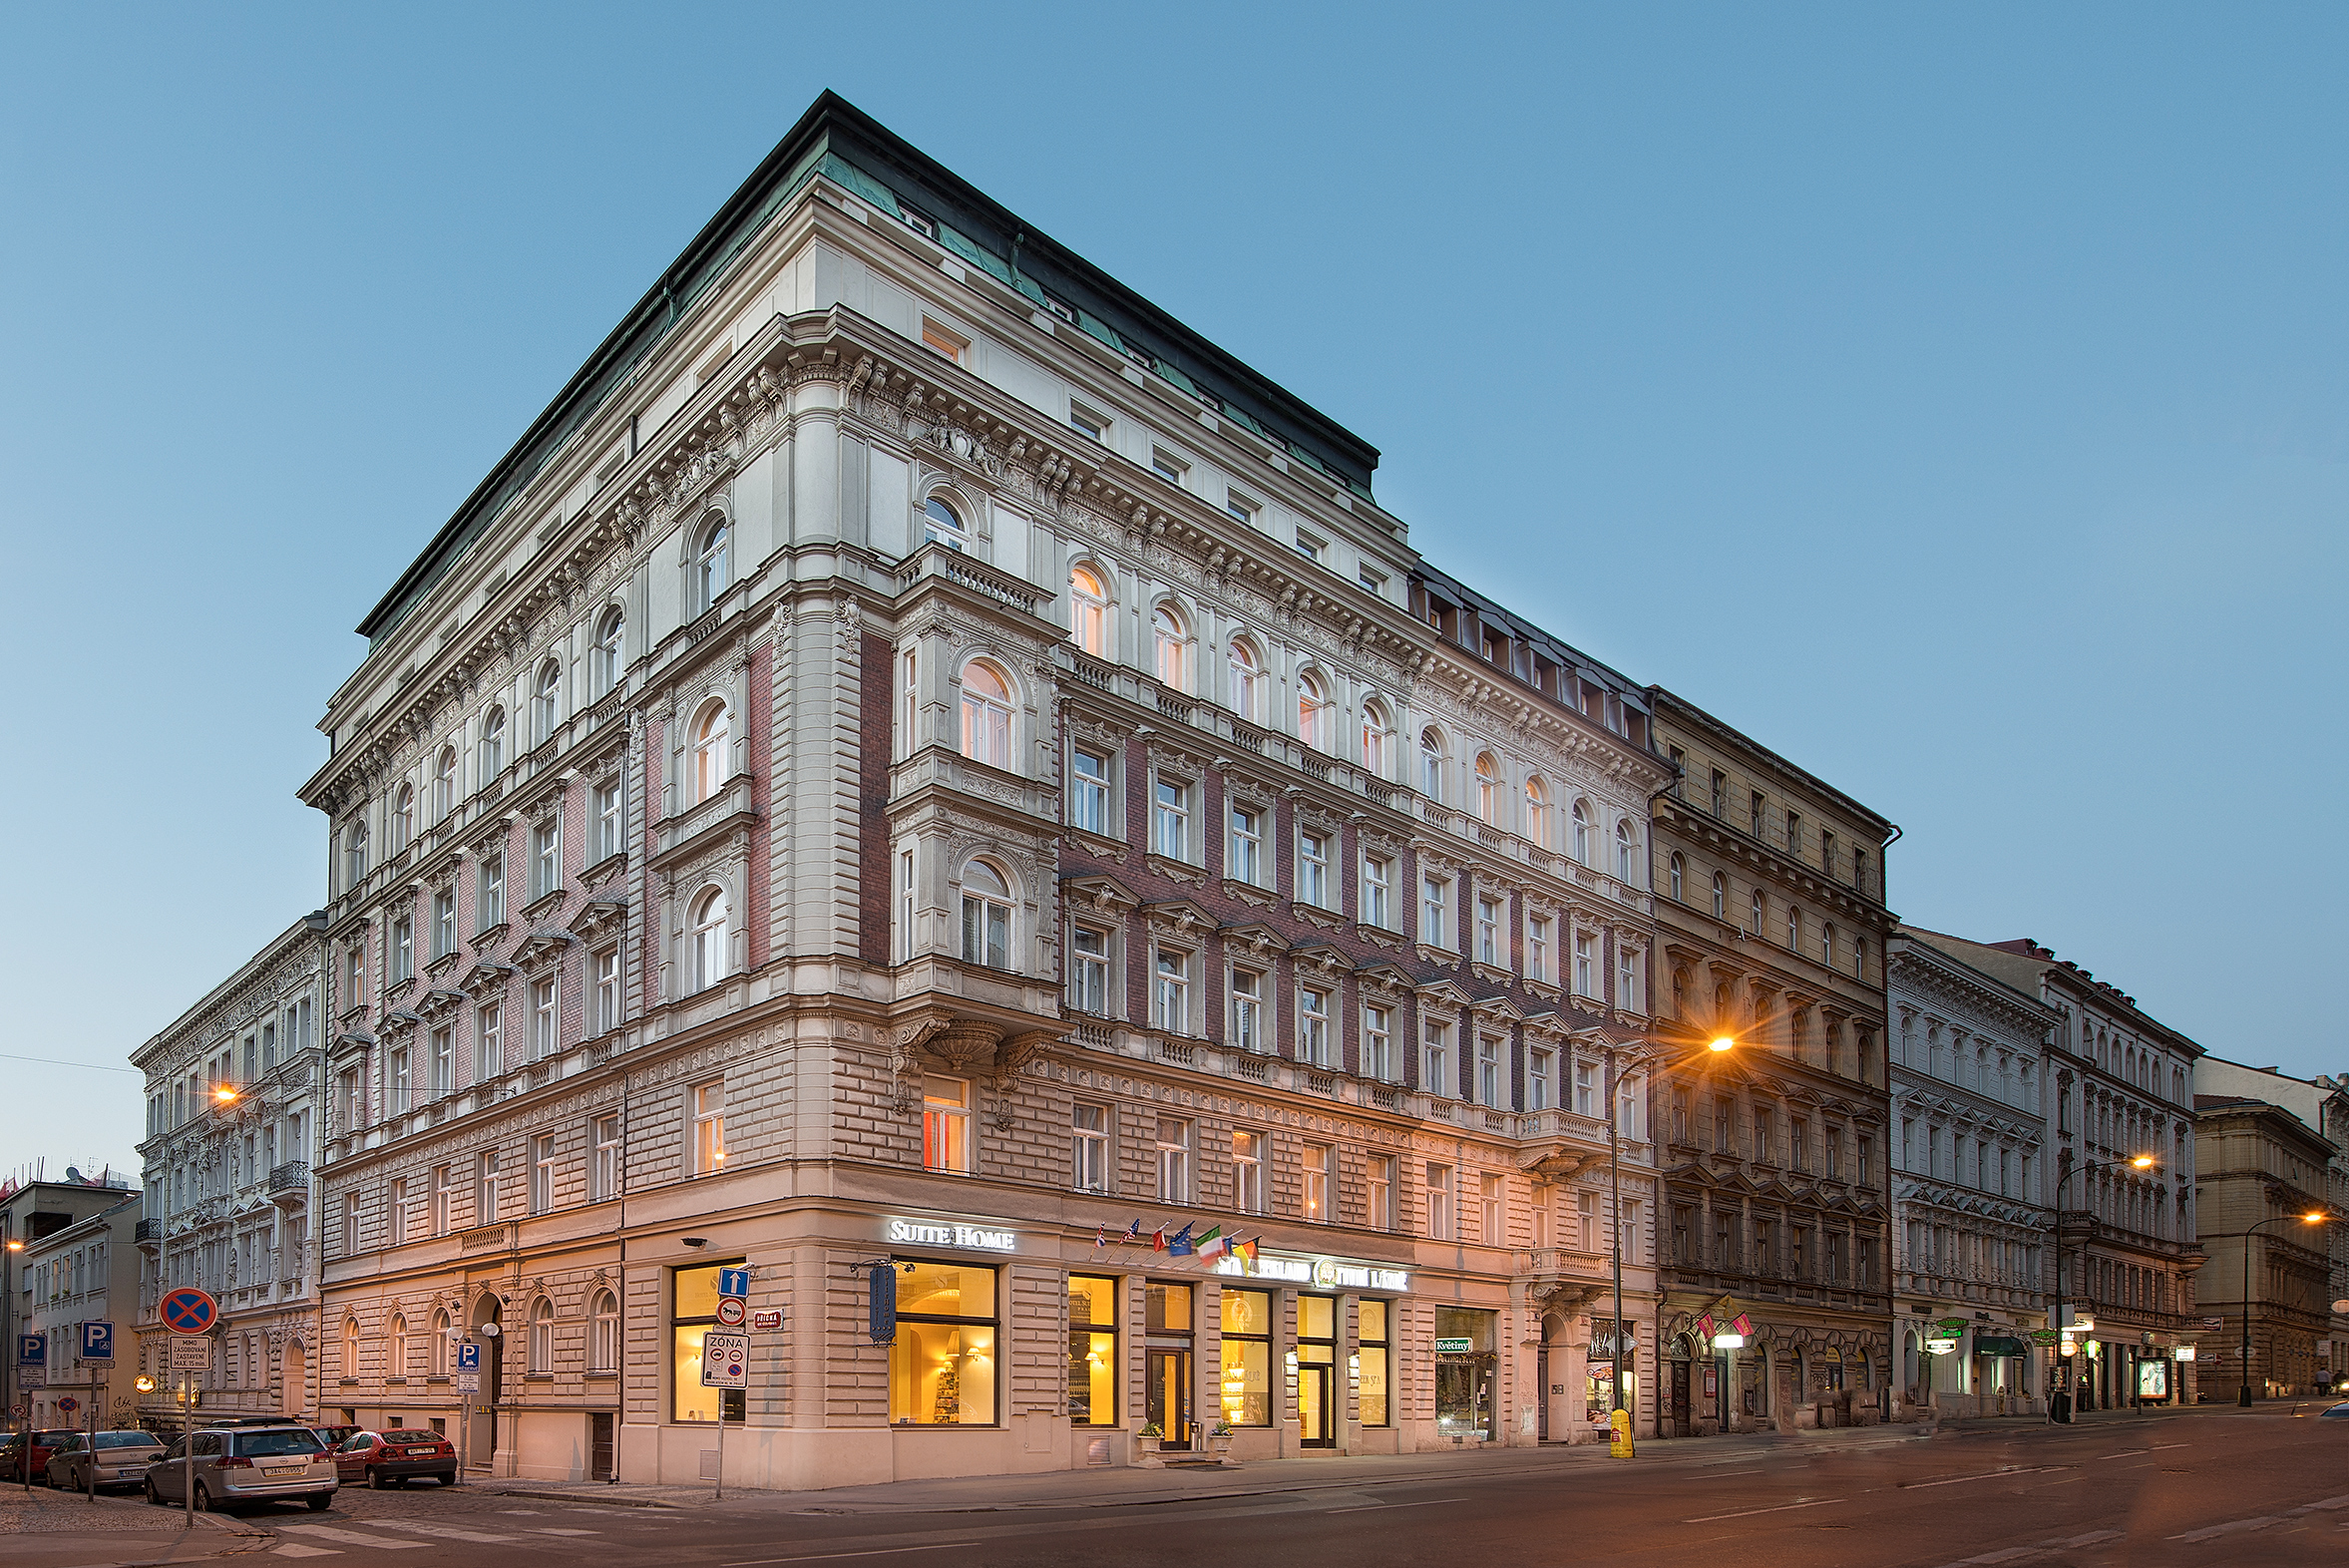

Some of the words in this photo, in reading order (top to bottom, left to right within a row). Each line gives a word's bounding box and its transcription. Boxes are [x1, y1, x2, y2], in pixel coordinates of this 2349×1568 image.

[890, 1221, 951, 1244] SUITE
[954, 1226, 1015, 1250] HOME
[1253, 1259, 1312, 1281] EERLAND
[88, 1326, 108, 1348] P
[710, 1337, 743, 1349] ZÓNA
[24, 1339, 41, 1357] P
[463, 1346, 476, 1362] P
[1436, 1341, 1469, 1352] Květiny
